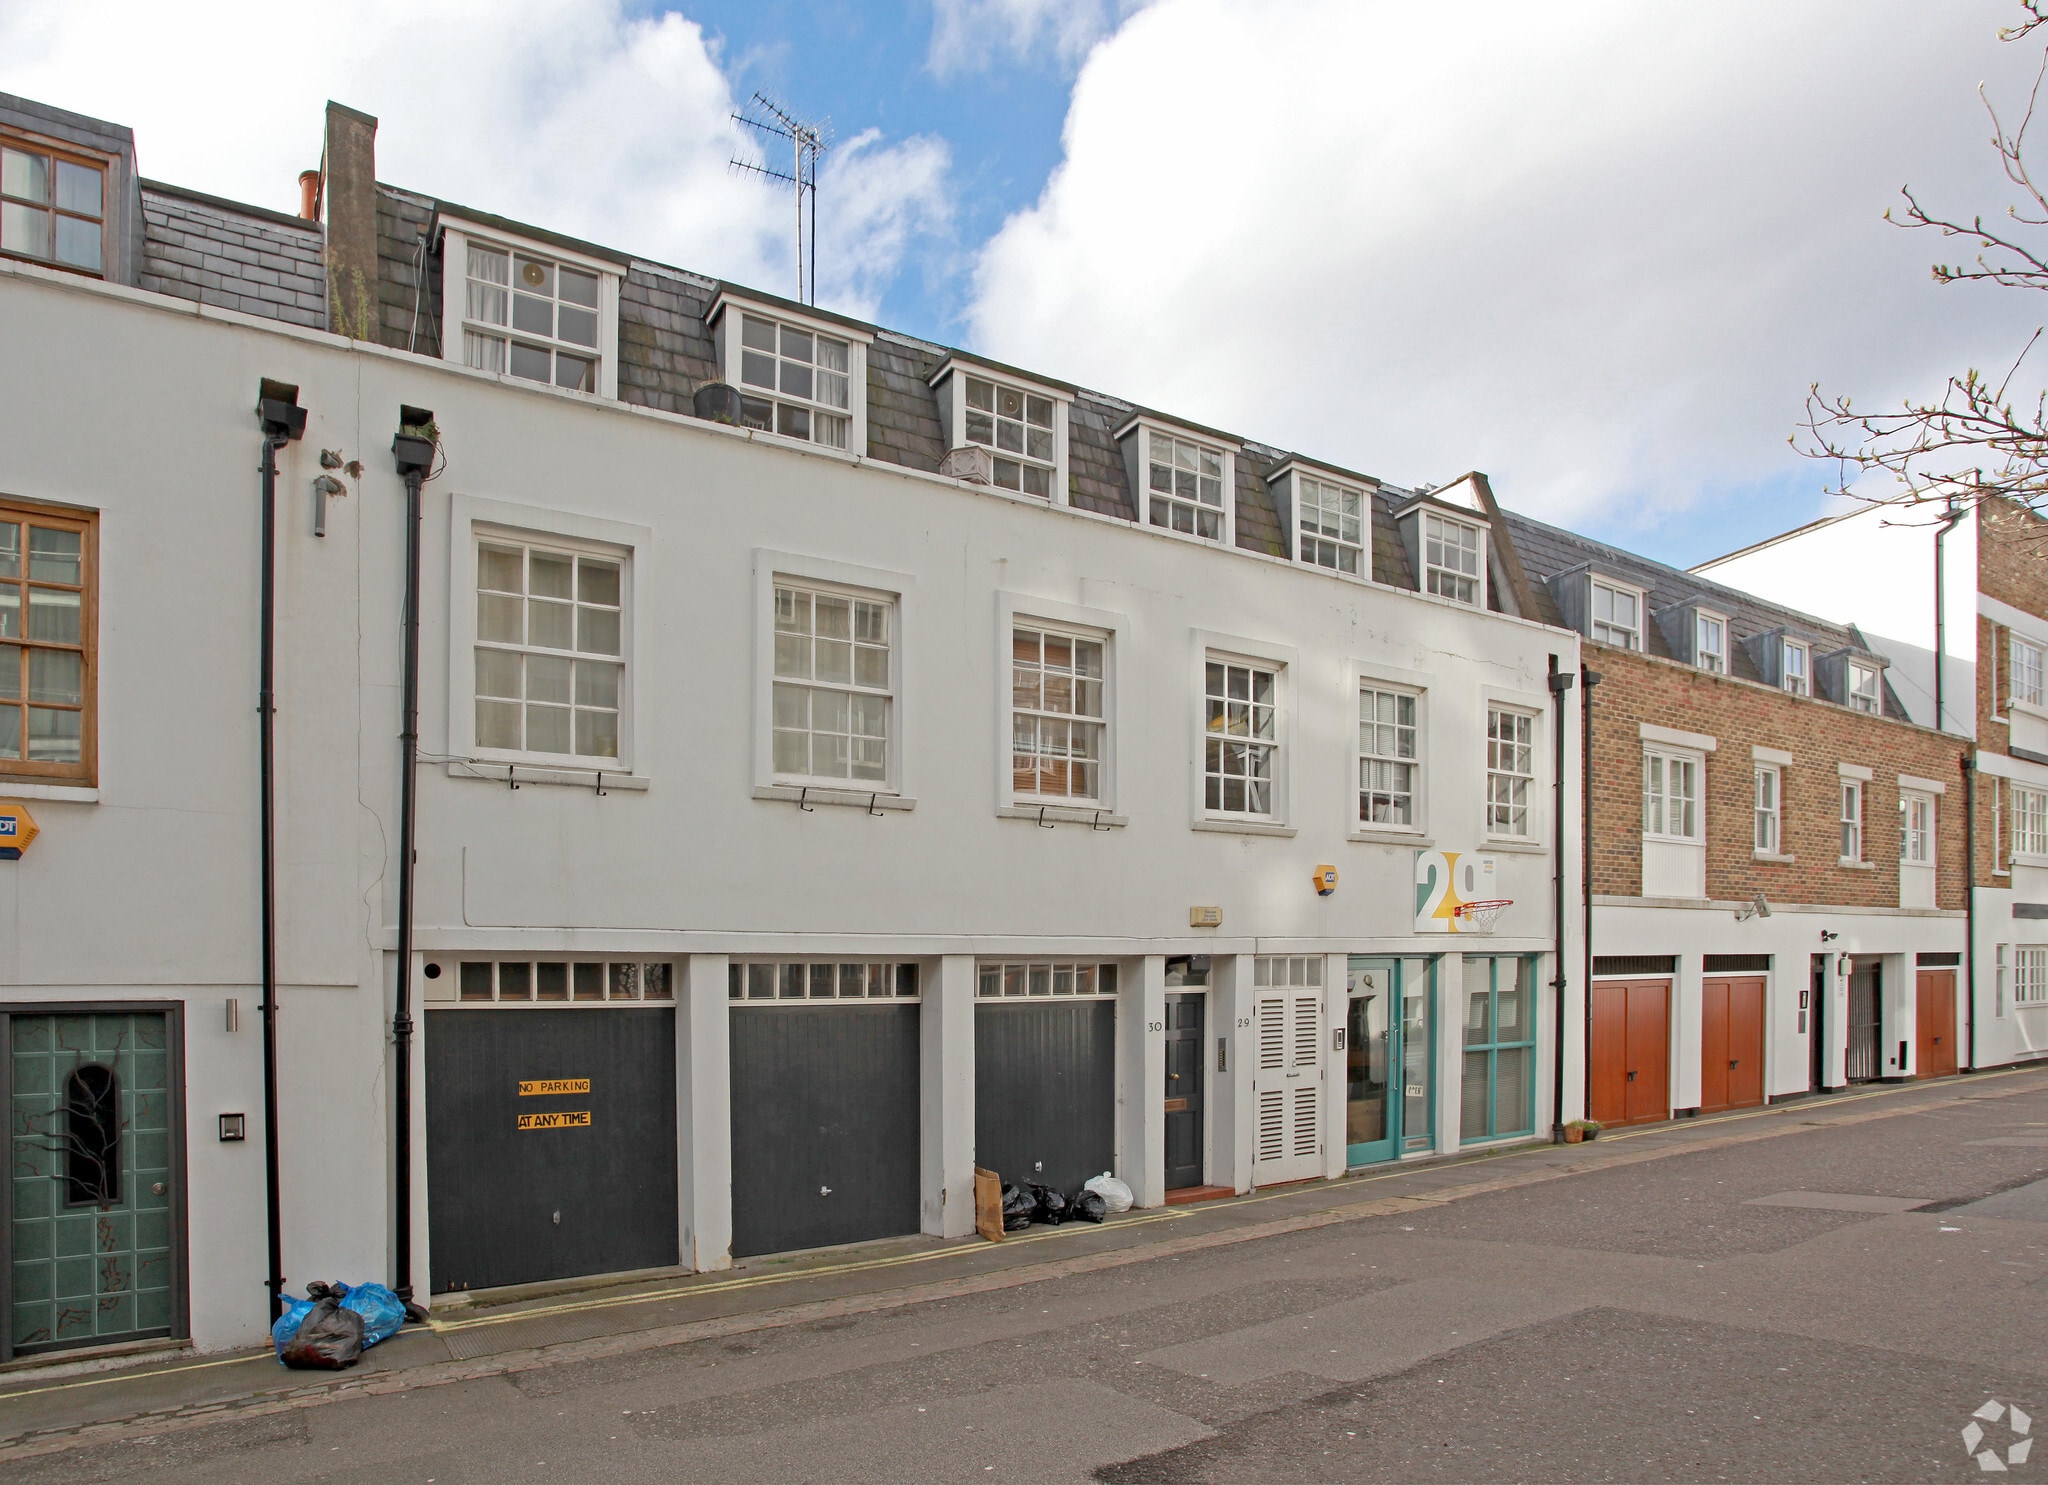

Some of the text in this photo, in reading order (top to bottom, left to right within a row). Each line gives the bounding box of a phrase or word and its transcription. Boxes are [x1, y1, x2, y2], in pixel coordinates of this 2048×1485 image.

[0, 820, 15, 832] DT
[1148, 1021, 1163, 1032] 30
[1237, 1018, 1250, 1028] 29
[519, 1081, 589, 1093] NO PARKING
[518, 1112, 589, 1128] AT ANY TIME
